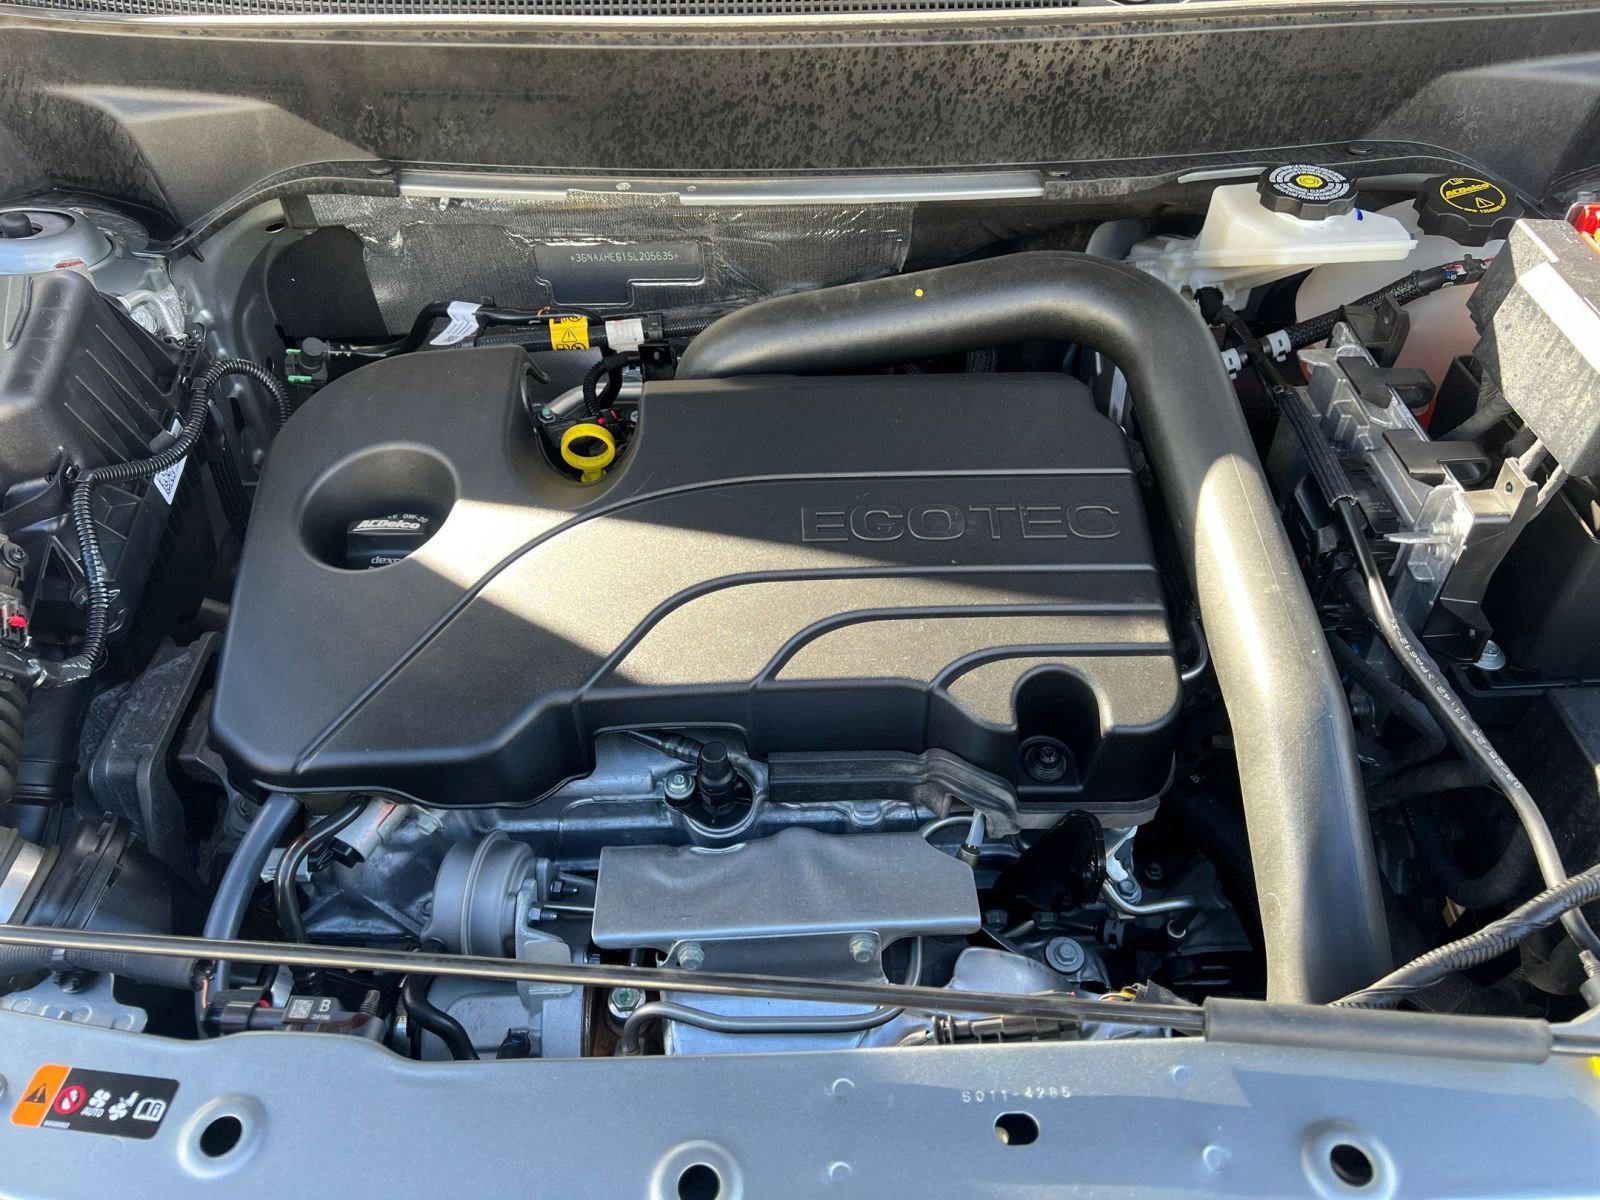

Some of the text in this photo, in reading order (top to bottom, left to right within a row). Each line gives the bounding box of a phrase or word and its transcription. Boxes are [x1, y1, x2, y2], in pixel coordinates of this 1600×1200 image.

[355, 519, 421, 530] ACDelco
[801, 502, 1121, 541] ECOTEC
[320, 999, 331, 1011] B
[81, 1106, 104, 1118] AUTO
